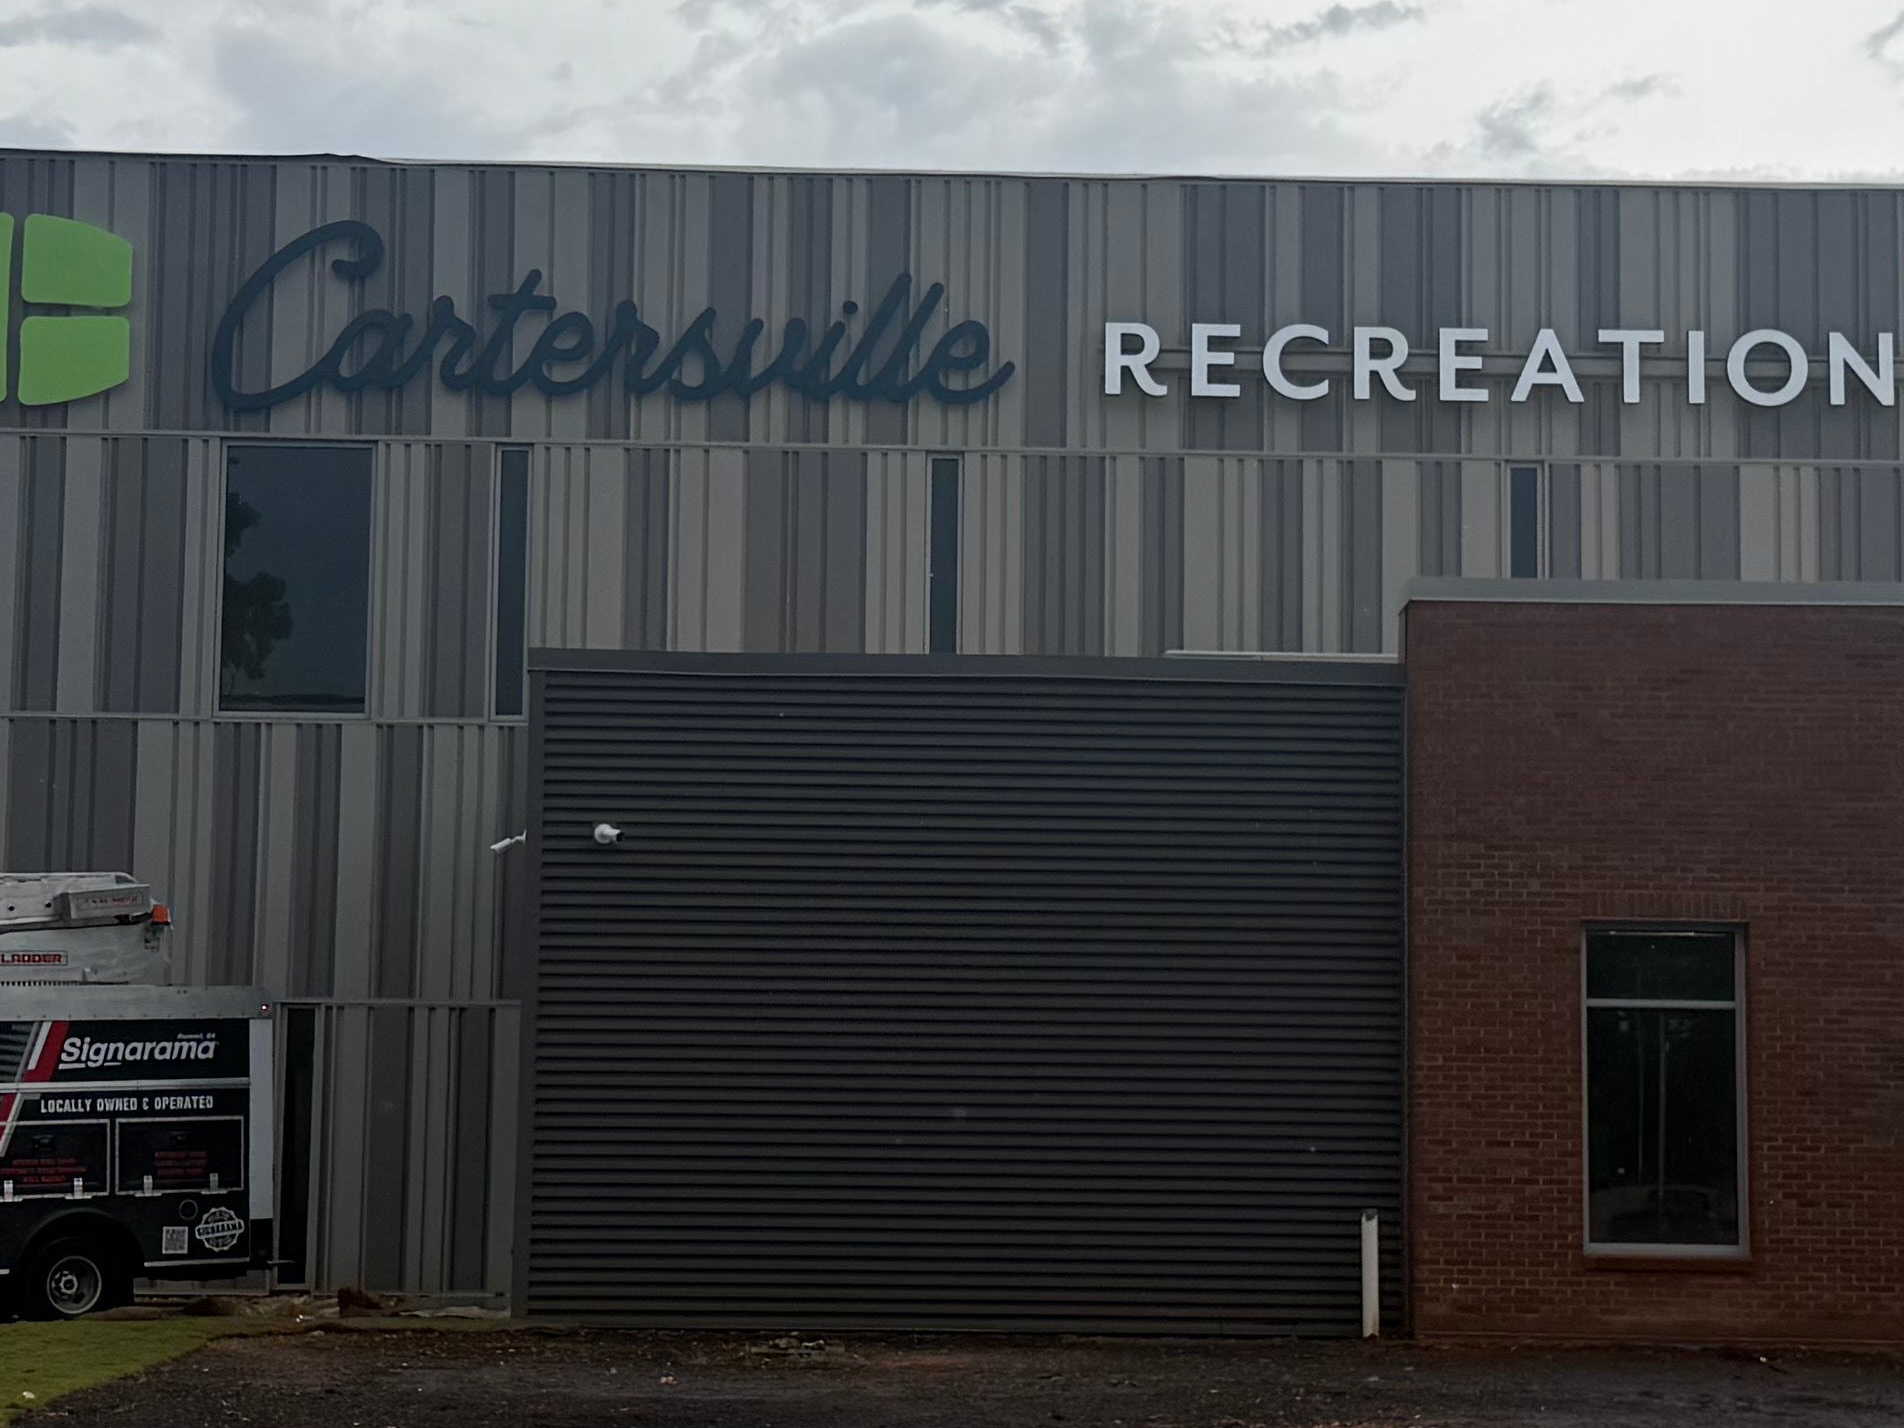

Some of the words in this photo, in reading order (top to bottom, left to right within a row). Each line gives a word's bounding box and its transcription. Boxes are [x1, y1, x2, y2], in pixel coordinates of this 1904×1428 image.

[211, 219, 1014, 410] Cartersville
[1104, 322, 1894, 408] RECREATION
[1, 954, 63, 964] LADDER
[59, 1036, 216, 1069] Signarama
[40, 1098, 93, 1113] LOCALLY
[96, 1097, 138, 1112] OWNED
[154, 1095, 214, 1110] OPERATED
